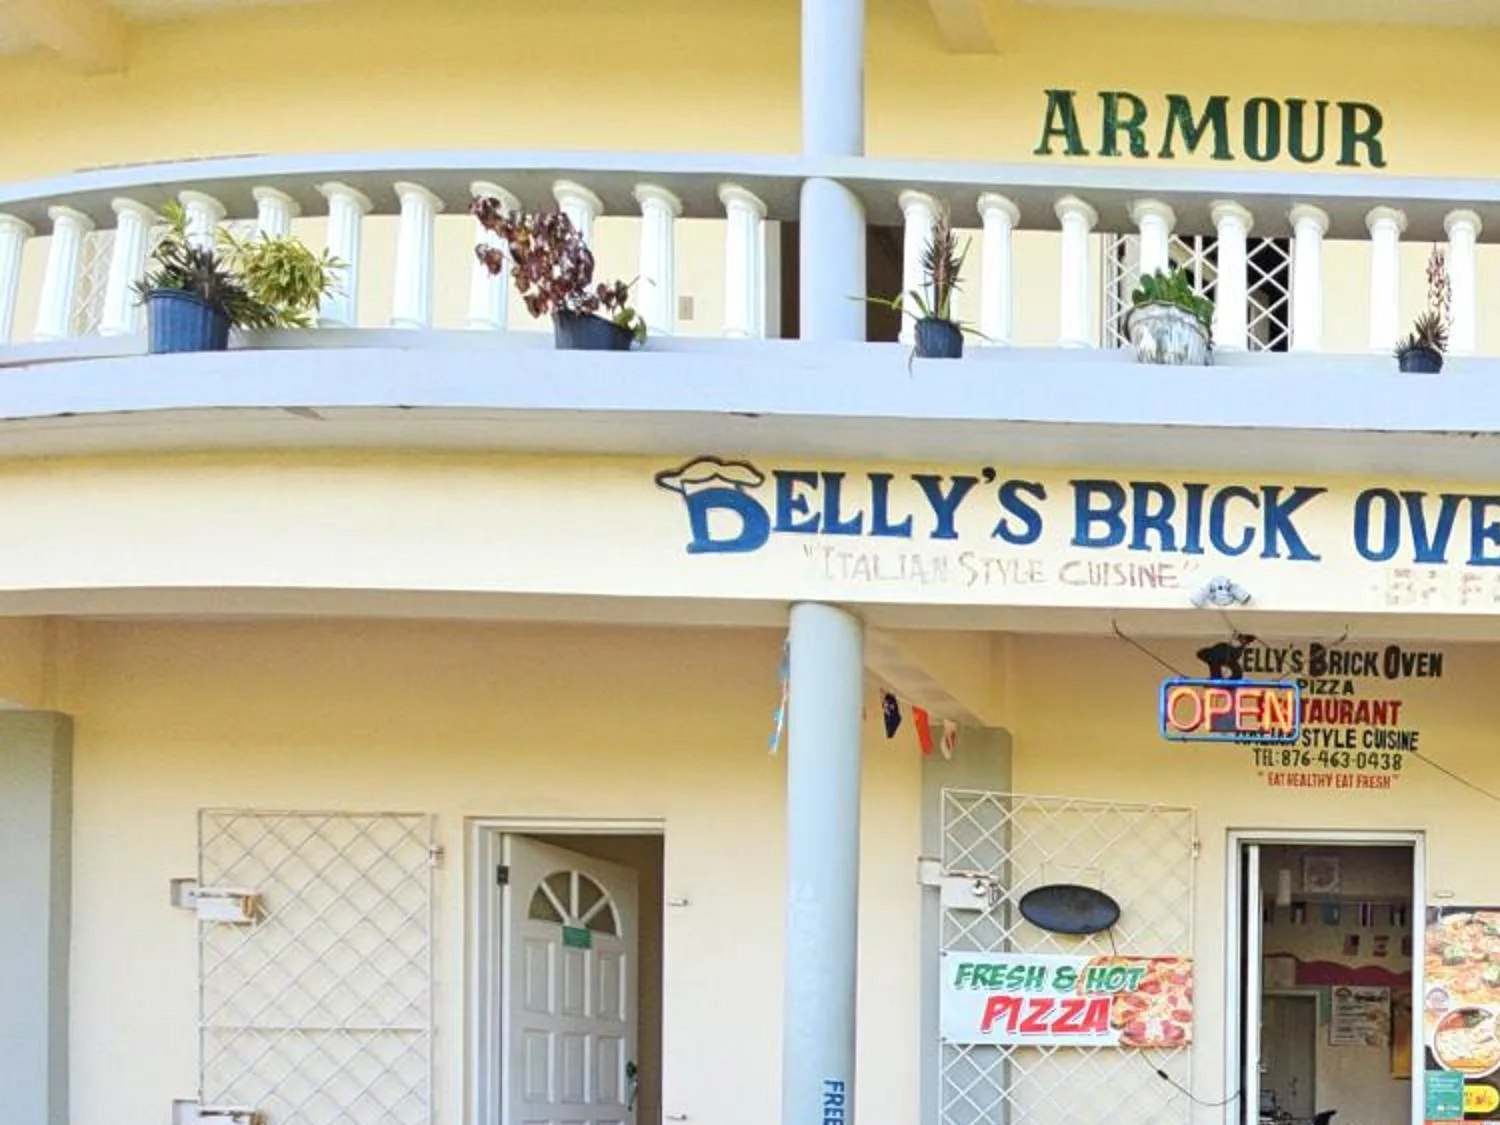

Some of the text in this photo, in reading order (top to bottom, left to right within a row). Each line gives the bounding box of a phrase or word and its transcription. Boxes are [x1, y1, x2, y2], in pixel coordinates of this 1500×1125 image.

[1033, 89, 1387, 168] ARMOUR
[686, 467, 1043, 553] DELLY'S
[1071, 479, 1328, 562] BRICK
[958, 551, 1047, 588] STYLE
[1309, 642, 1379, 678] BRICK
[1384, 645, 1443, 680] OVEN
[1298, 679, 1355, 696] PIZZA
[1166, 686, 1294, 732] OPEN
[1257, 698, 1402, 726] TAURANT
[1302, 730, 1356, 748] STYLE
[1363, 730, 1418, 751] CUISINE
[1287, 772, 1332, 788] HEALTHY
[1335, 773, 1353, 789] EAT
[954, 963, 1148, 992] FRESH & HOT
[980, 995, 1111, 1034] PIZZA
